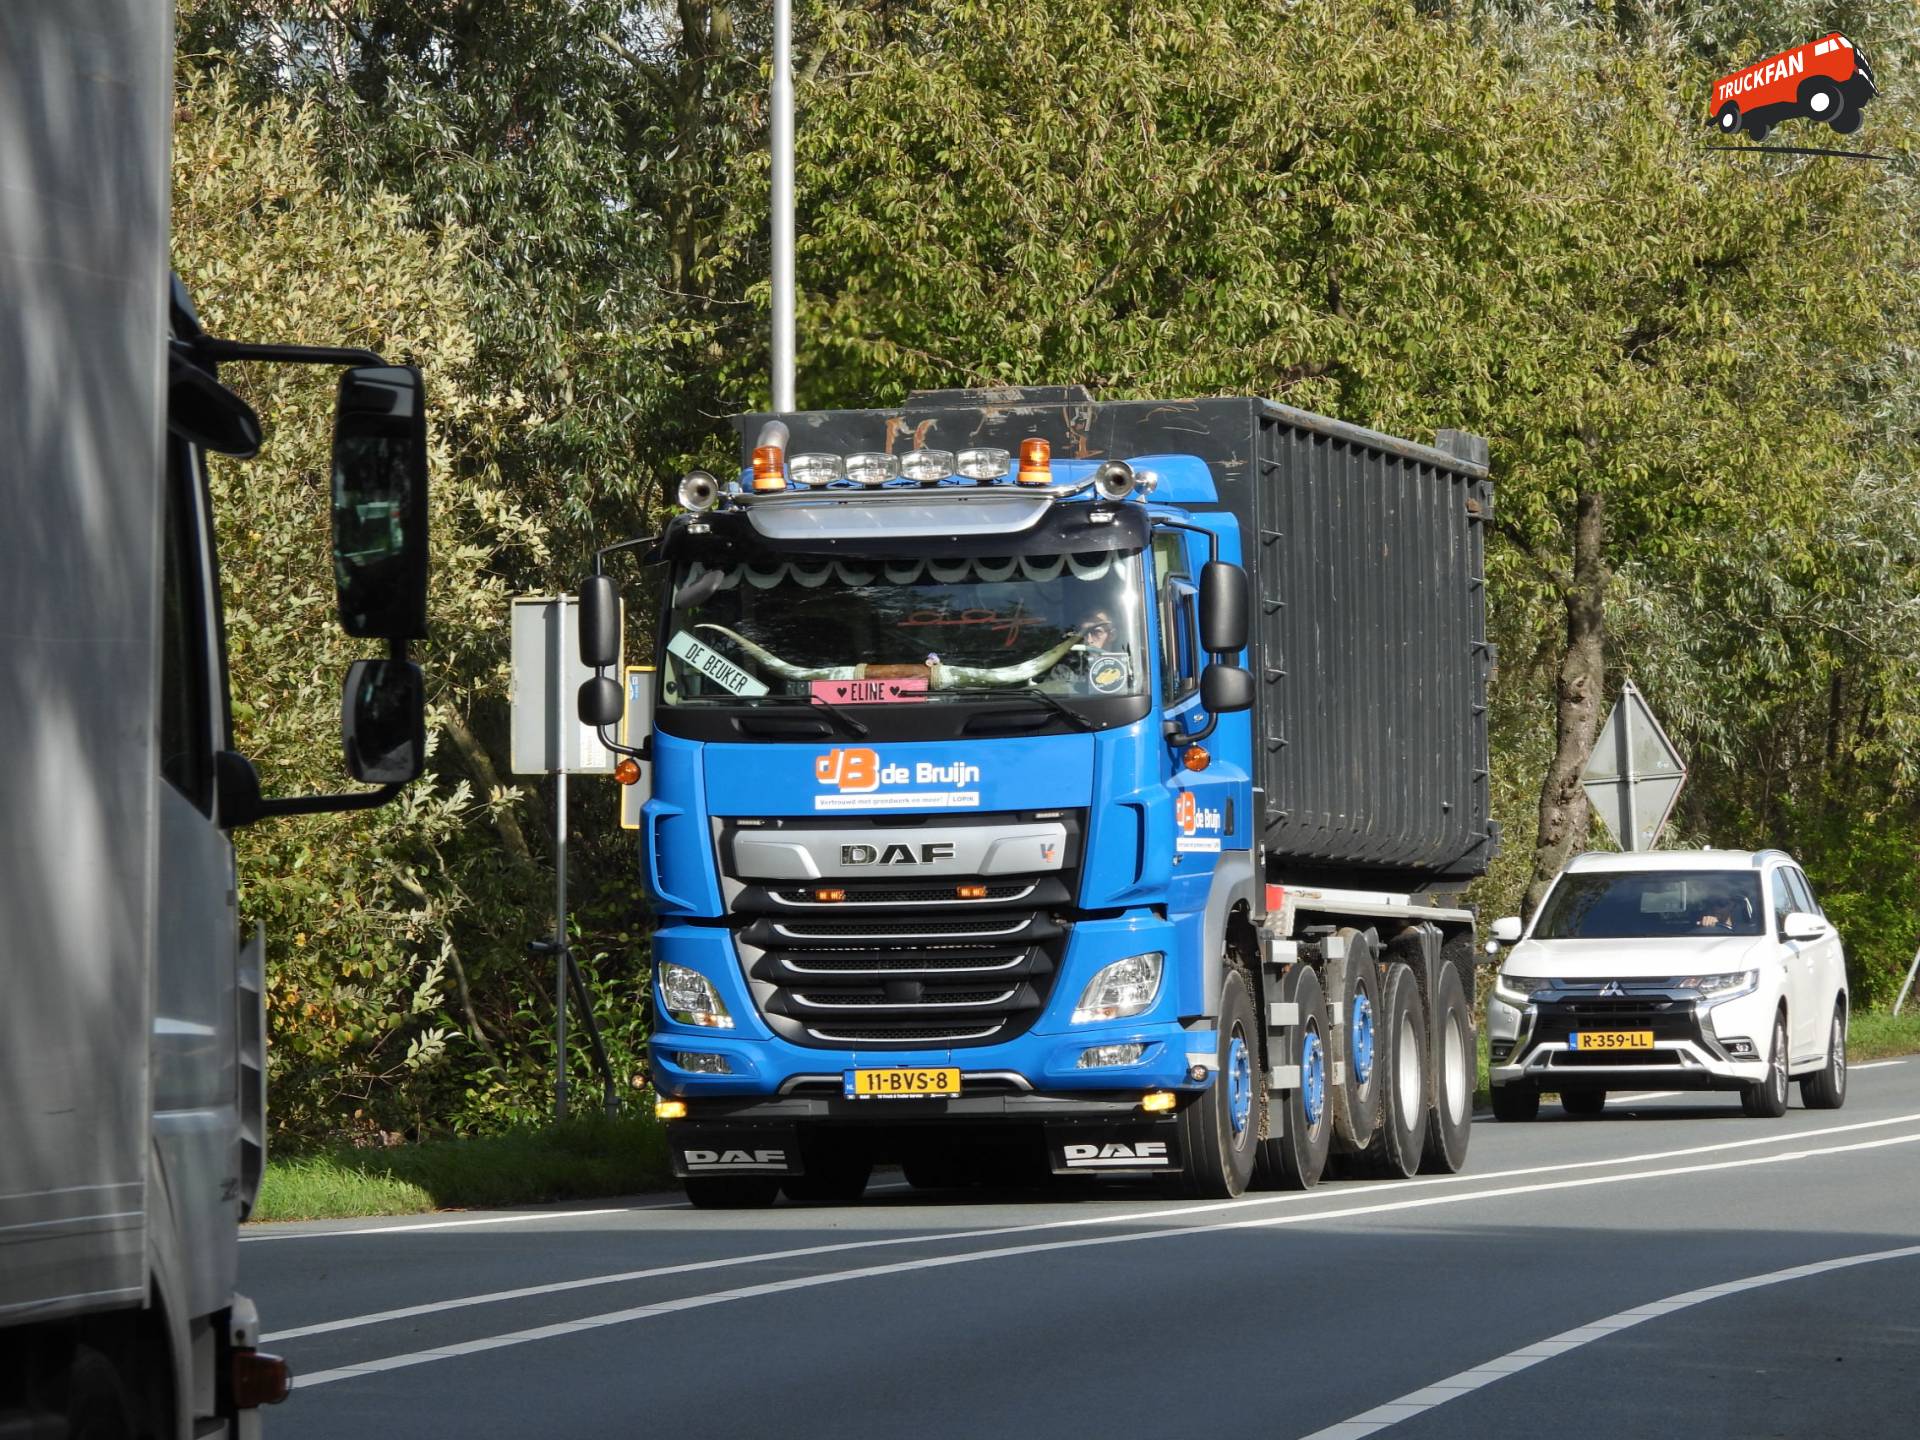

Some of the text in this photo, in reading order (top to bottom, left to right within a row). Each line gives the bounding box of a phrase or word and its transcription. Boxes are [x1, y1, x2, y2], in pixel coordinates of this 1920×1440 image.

[685, 643, 748, 693] DE BEUKER
[851, 682, 885, 702] ELINE
[880, 763, 910, 785] de
[916, 761, 980, 788] Bruijn
[840, 843, 955, 866] DAF
[1583, 1034, 1648, 1047] R-359-LL
[867, 1072, 948, 1090] 11-BVS-8
[683, 1149, 787, 1163] DAF
[1063, 1142, 1168, 1160] DAF
